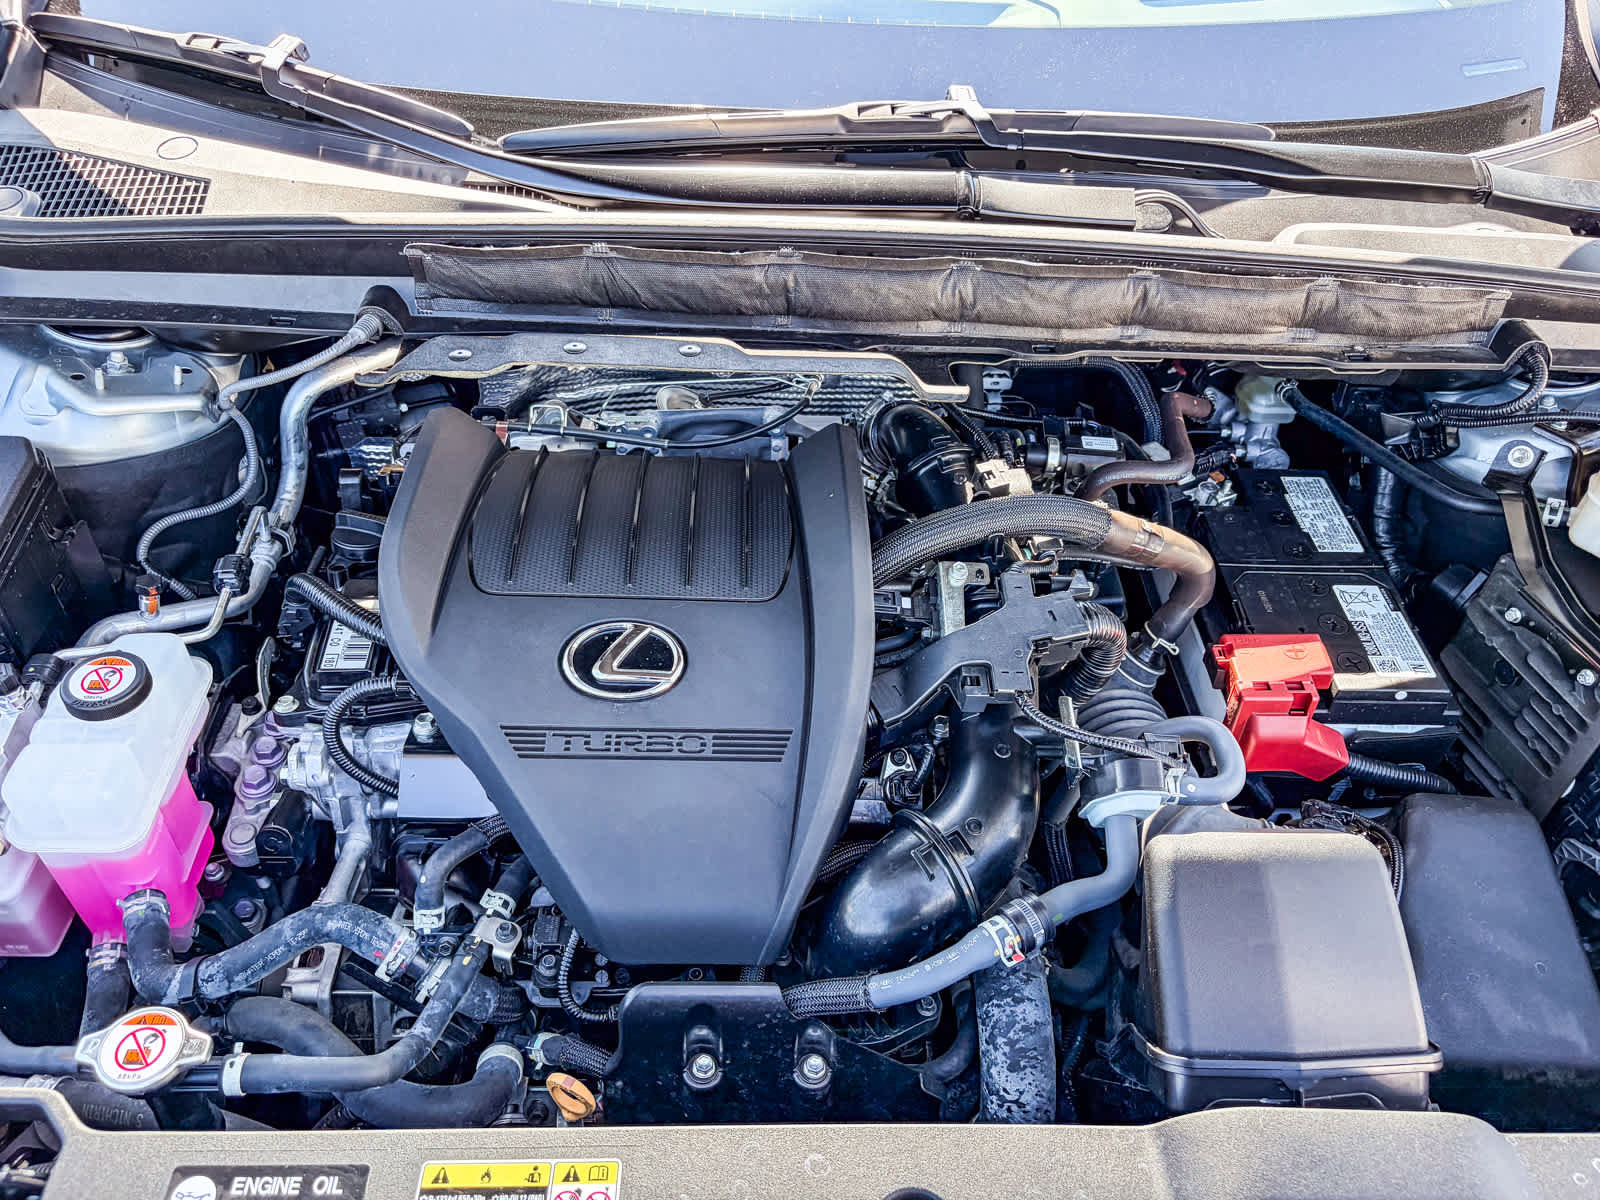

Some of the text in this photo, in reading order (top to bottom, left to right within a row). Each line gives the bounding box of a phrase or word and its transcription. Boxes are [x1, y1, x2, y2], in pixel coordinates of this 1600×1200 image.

[551, 732, 707, 755] TURBO
[230, 1175, 344, 1196] ENGINE OIL
